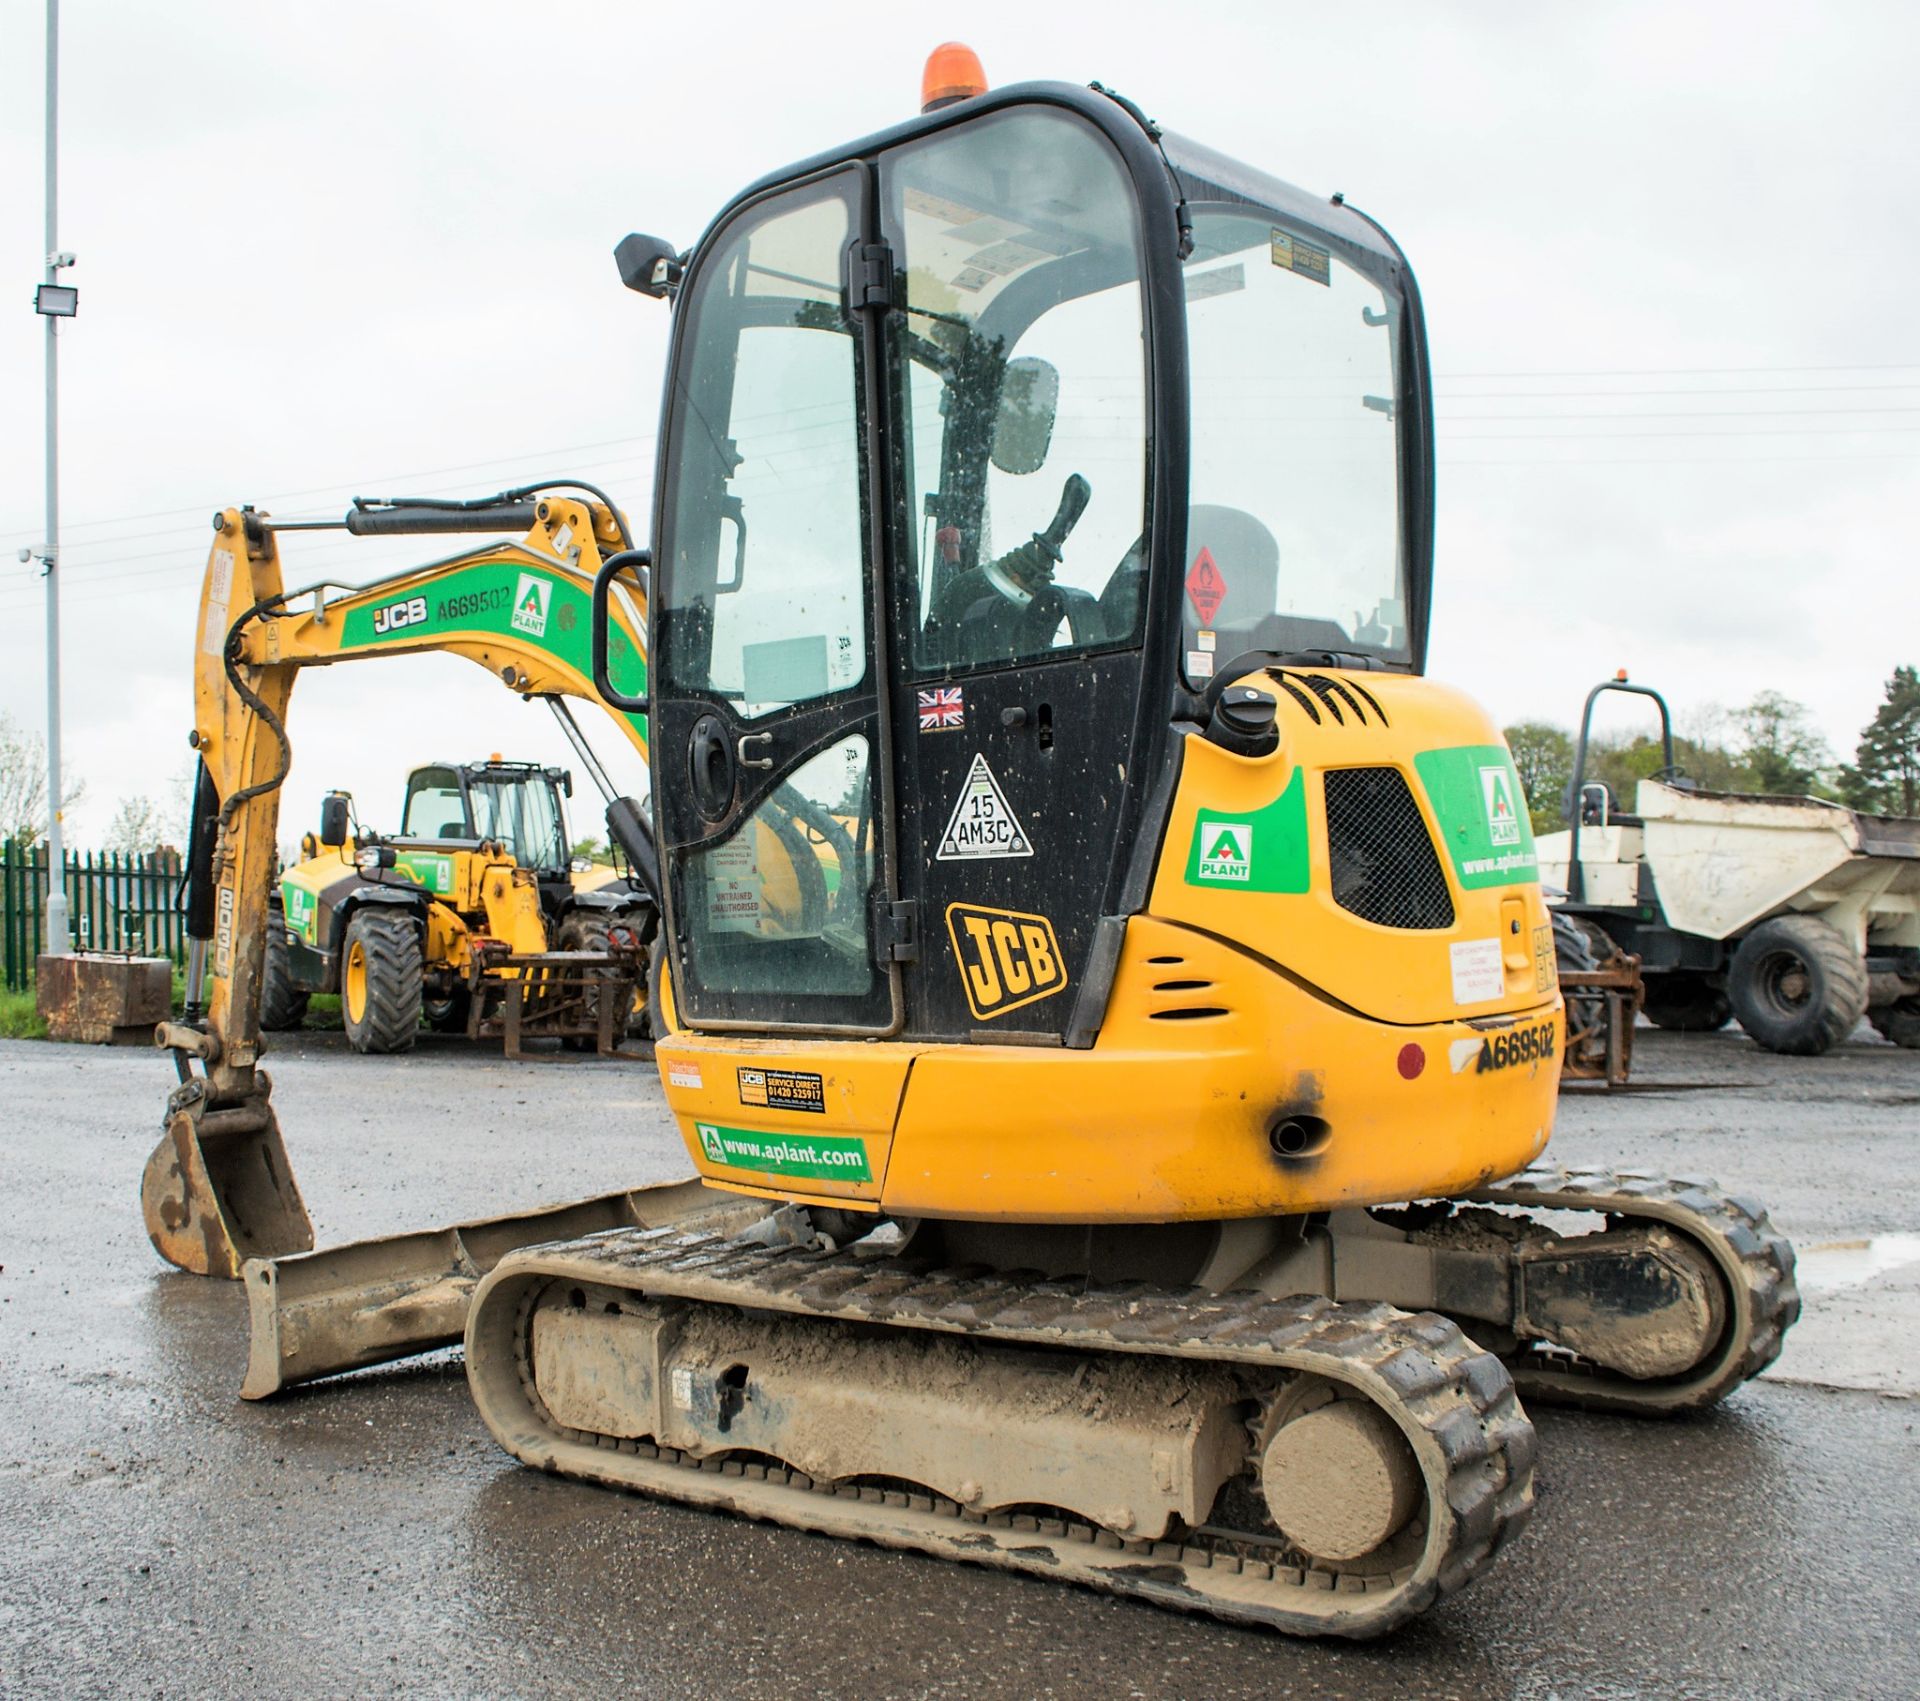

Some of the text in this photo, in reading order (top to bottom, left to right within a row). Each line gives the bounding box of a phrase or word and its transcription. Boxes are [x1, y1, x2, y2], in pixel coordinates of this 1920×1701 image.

[437, 586, 511, 622] A669502
[519, 583, 543, 617] A
[374, 597, 428, 634] JCB
[513, 615, 544, 633] PLANT
[971, 795, 994, 818] 15
[1493, 775, 1514, 818] A
[959, 820, 1009, 844] AM3C
[1491, 823, 1518, 840] PLANT
[1206, 830, 1245, 861] A
[1201, 863, 1248, 877] PLANT
[711, 903, 758, 913] UNAUTHORISED
[716, 892, 752, 901] UNTRAINED
[964, 916, 1057, 1006] JCB
[1476, 1022, 1554, 1074] A669502
[742, 1073, 764, 1085] JCB
[767, 1078, 820, 1090] SERVICE DIRECT
[768, 1086, 821, 1100] 01420 525917
[723, 1139, 863, 1166] www.aplant.com
